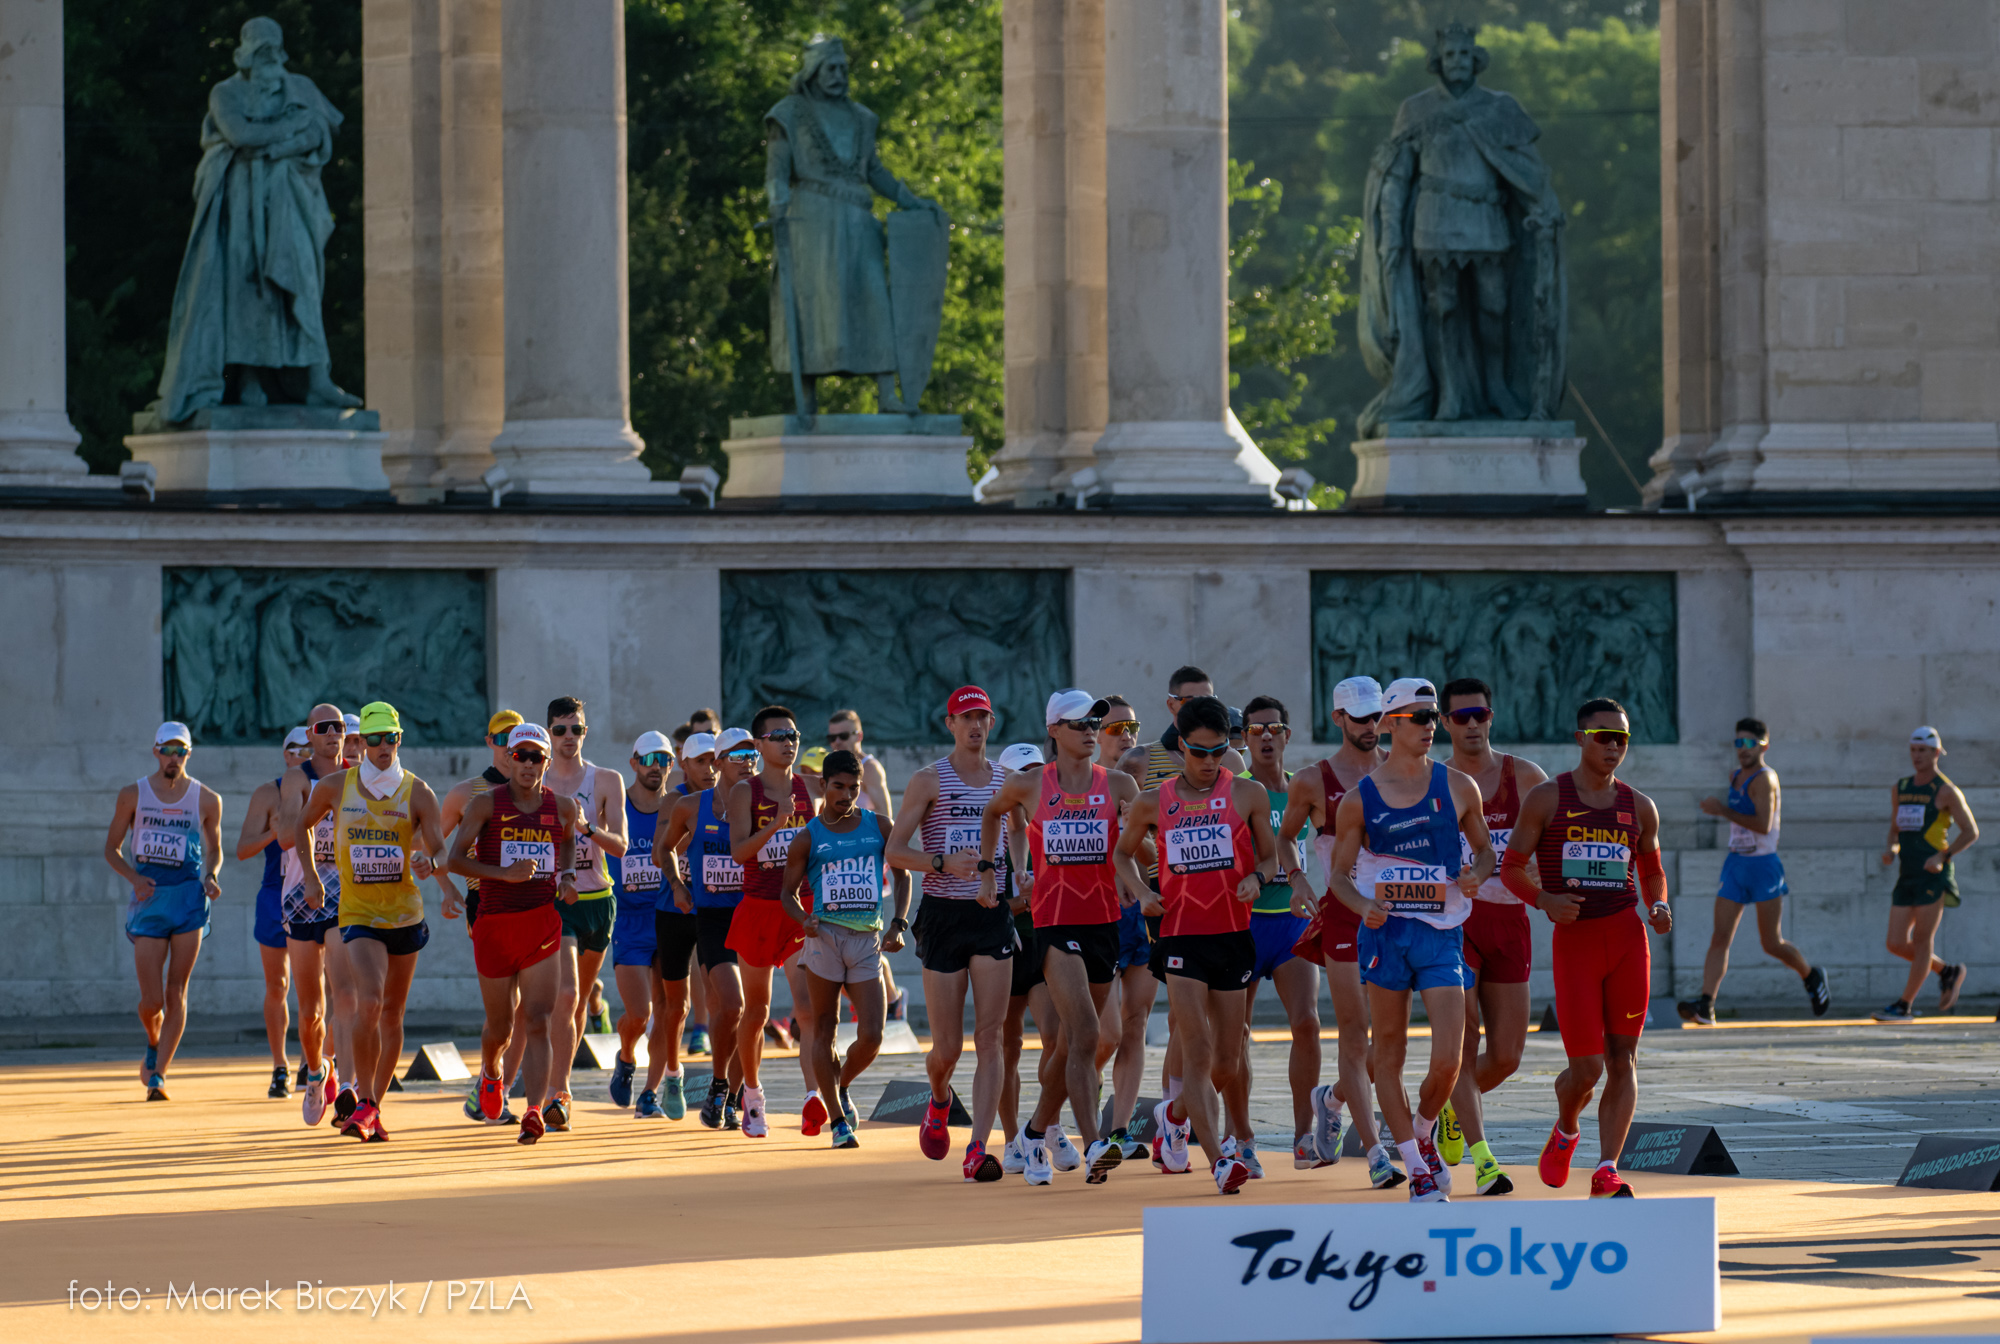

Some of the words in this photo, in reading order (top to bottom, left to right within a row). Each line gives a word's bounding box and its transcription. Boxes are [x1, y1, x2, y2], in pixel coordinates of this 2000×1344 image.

[958, 693, 987, 702] CANADA
[1054, 808, 1099, 821] JAPAN
[1174, 812, 1221, 829] JAPAN
[143, 816, 191, 829] FINLAND
[1060, 821, 1104, 835] TDK
[150, 831, 183, 847] TDK
[347, 828, 399, 842] SWEDEN
[500, 826, 553, 843] CHINA
[1183, 825, 1227, 843] TDK
[1566, 825, 1629, 847] CHINA
[143, 843, 178, 859] OJALA
[363, 846, 399, 858] TDK
[516, 843, 551, 856] TDK
[1047, 838, 1104, 853] KAWANO
[1180, 843, 1221, 862] NODA
[1394, 838, 1431, 853] ITALIA
[1582, 844, 1624, 860] TDK
[821, 855, 876, 875] INDIA
[1188, 861, 1223, 871] BUDAPEST
[1587, 861, 1607, 876] HE
[625, 870, 661, 884] ARÉVA
[837, 873, 873, 886] TDK
[1394, 867, 1441, 882] TDK
[1582, 880, 1616, 888] BUDAPEST
[830, 887, 873, 901] BABOO
[1384, 884, 1436, 900] STANO
[1634, 1128, 1687, 1151] WITNESS
[1622, 1153, 1634, 1163] THE
[1629, 1147, 1681, 1170] WONDER
[1230, 1228, 1428, 1311] Tokyo
[1429, 1227, 1628, 1290] Tokyo
